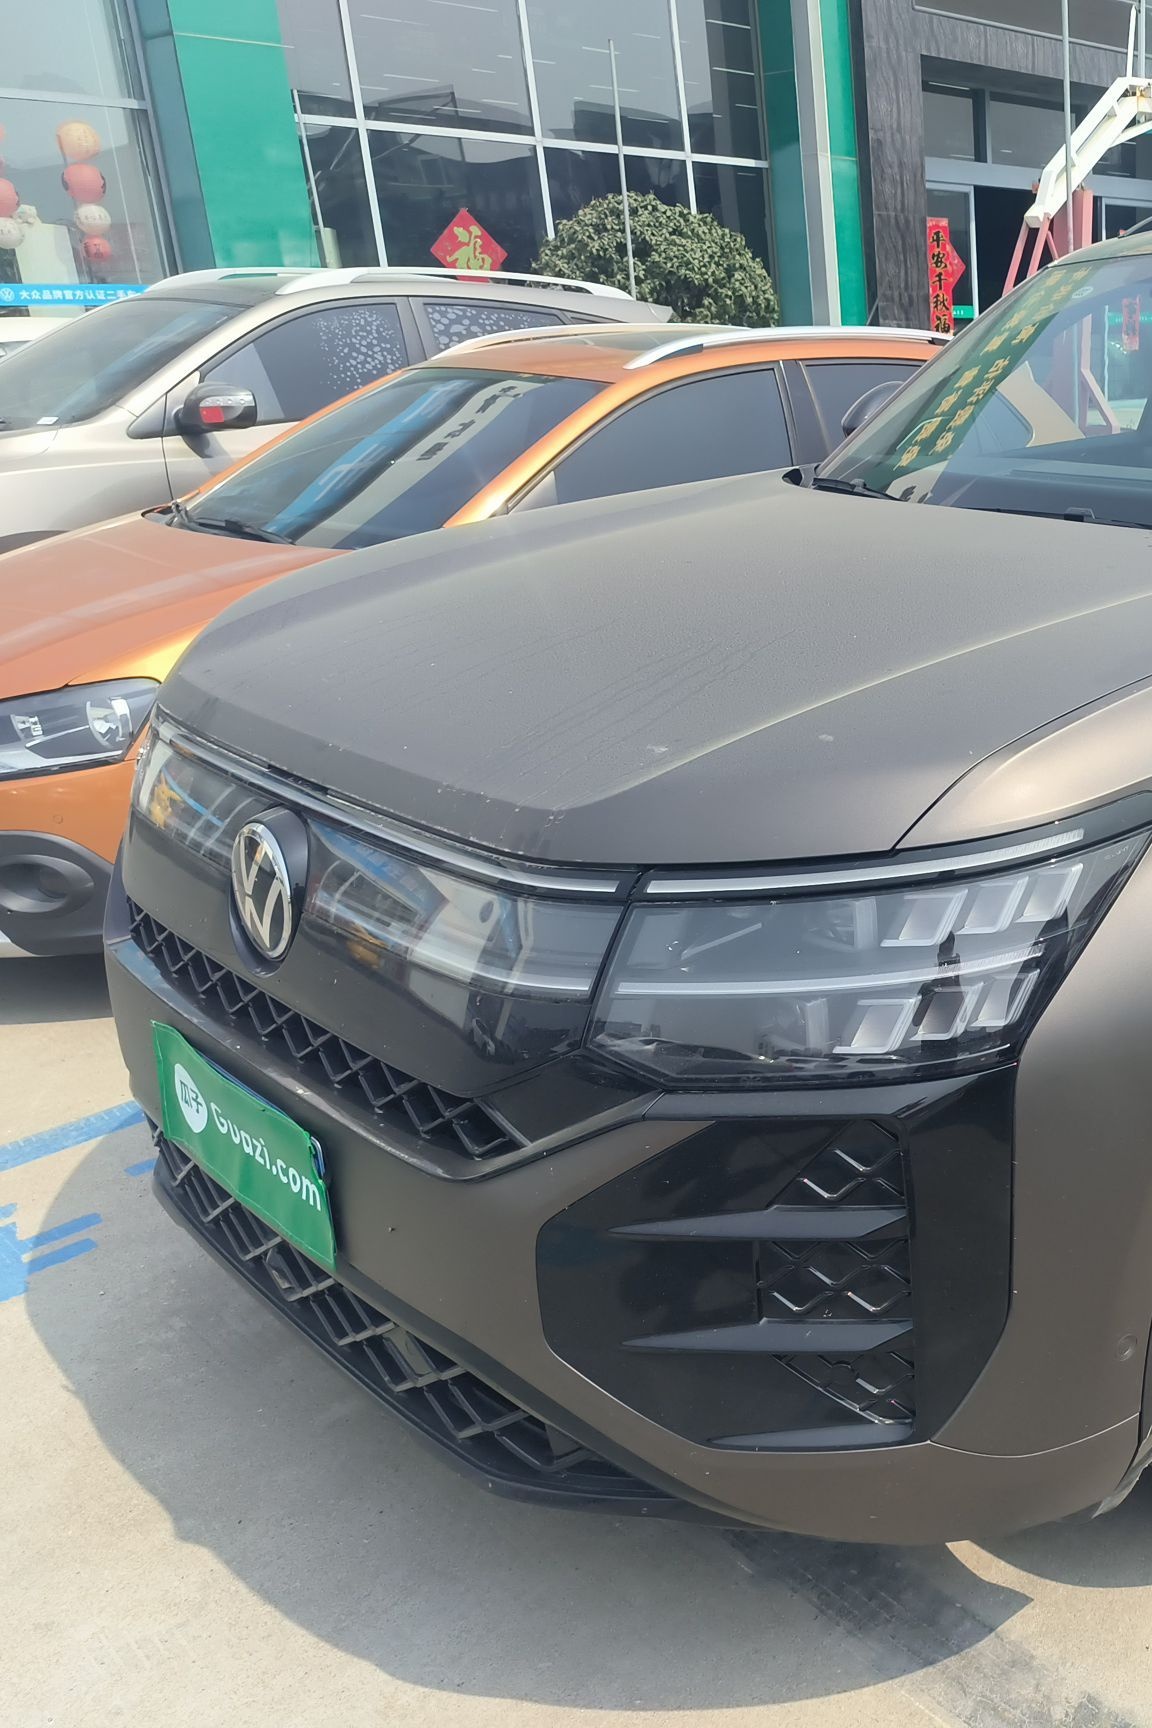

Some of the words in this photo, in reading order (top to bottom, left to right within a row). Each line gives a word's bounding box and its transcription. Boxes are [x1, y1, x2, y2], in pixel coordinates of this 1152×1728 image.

[446, 225, 492, 271] 福
[930, 230, 951, 334] 平安千秋福
[180, 1080, 203, 1114] 瓜子
[210, 1101, 322, 1212] Guazi.com
